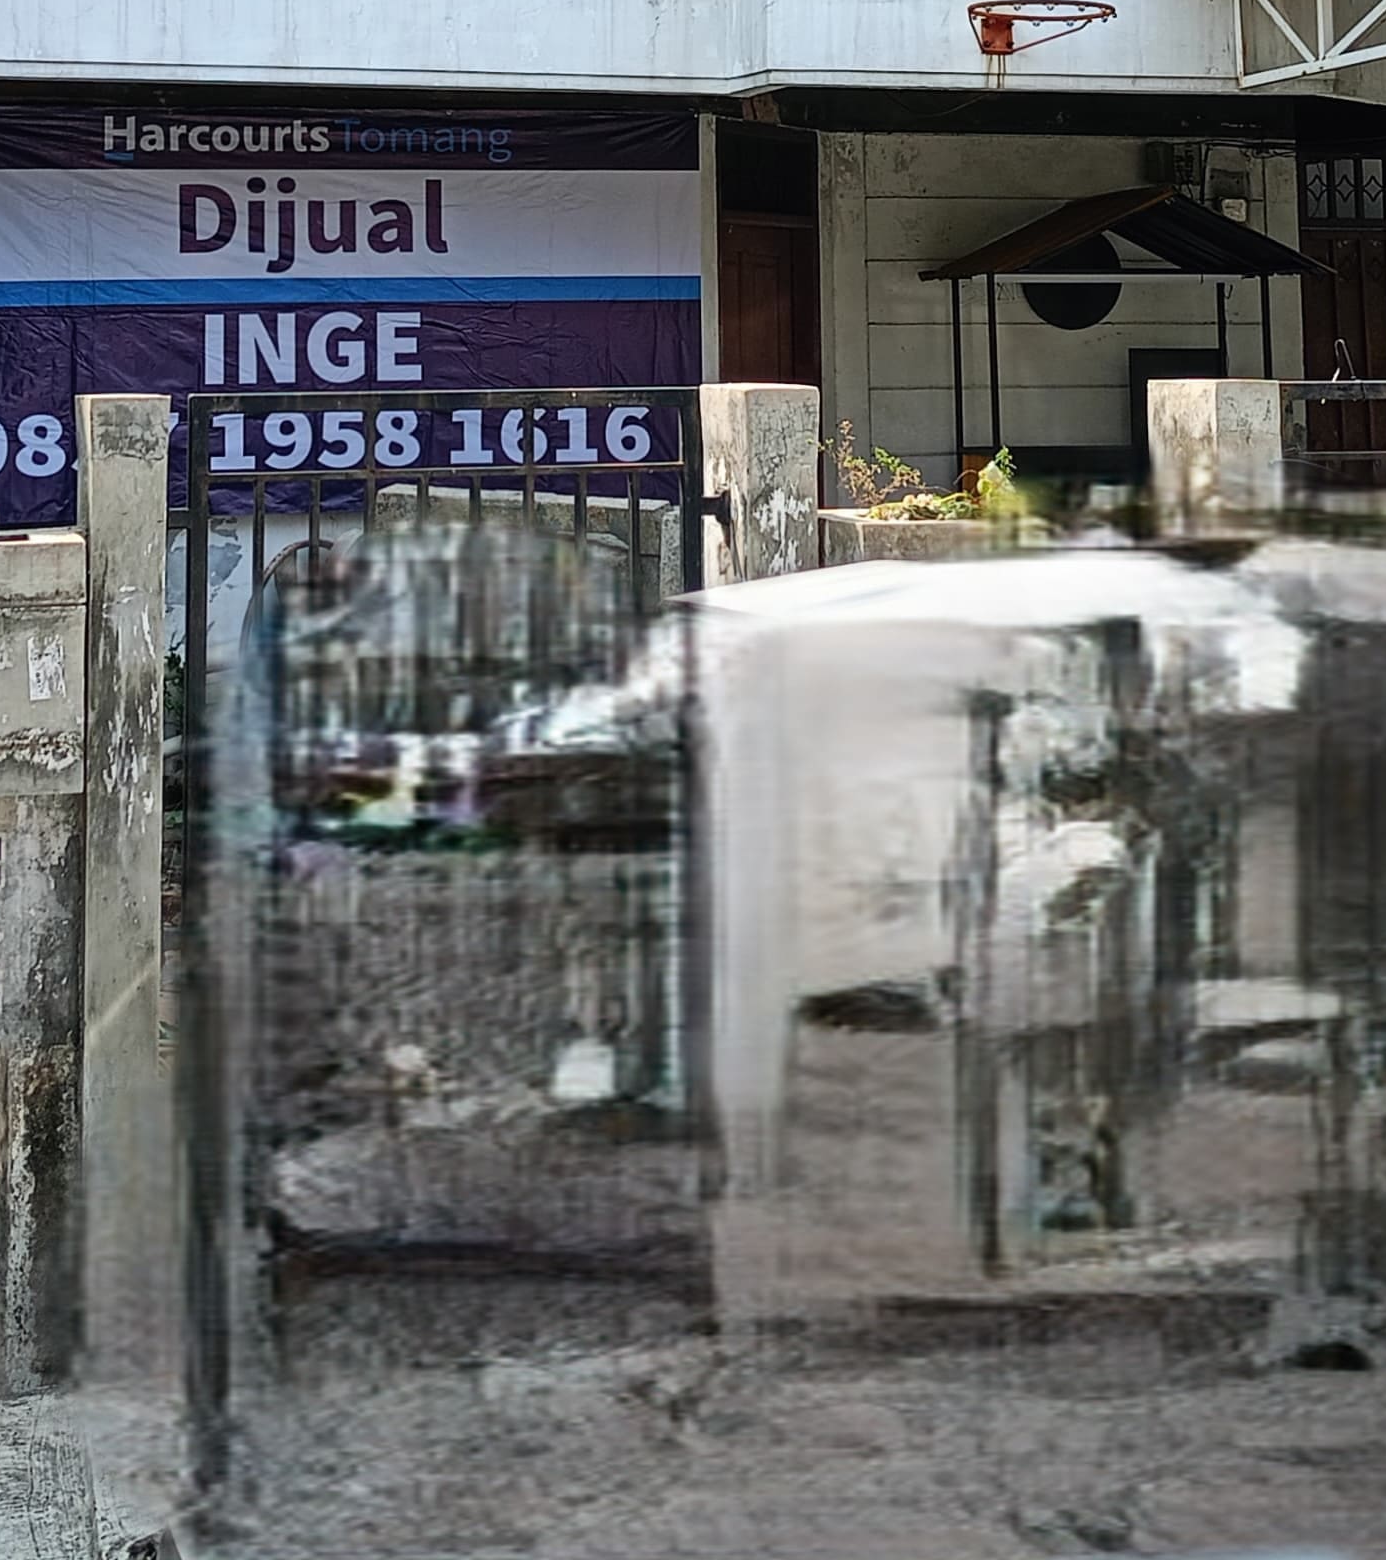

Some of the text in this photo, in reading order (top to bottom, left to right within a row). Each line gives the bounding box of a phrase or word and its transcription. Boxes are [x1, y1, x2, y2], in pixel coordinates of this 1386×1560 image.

[104, 115, 513, 163] Harcourts Tomang
[179, 176, 450, 274] Dijual
[204, 311, 422, 385] INGE
[209, 409, 422, 471] 1958
[450, 406, 653, 466] 1616
